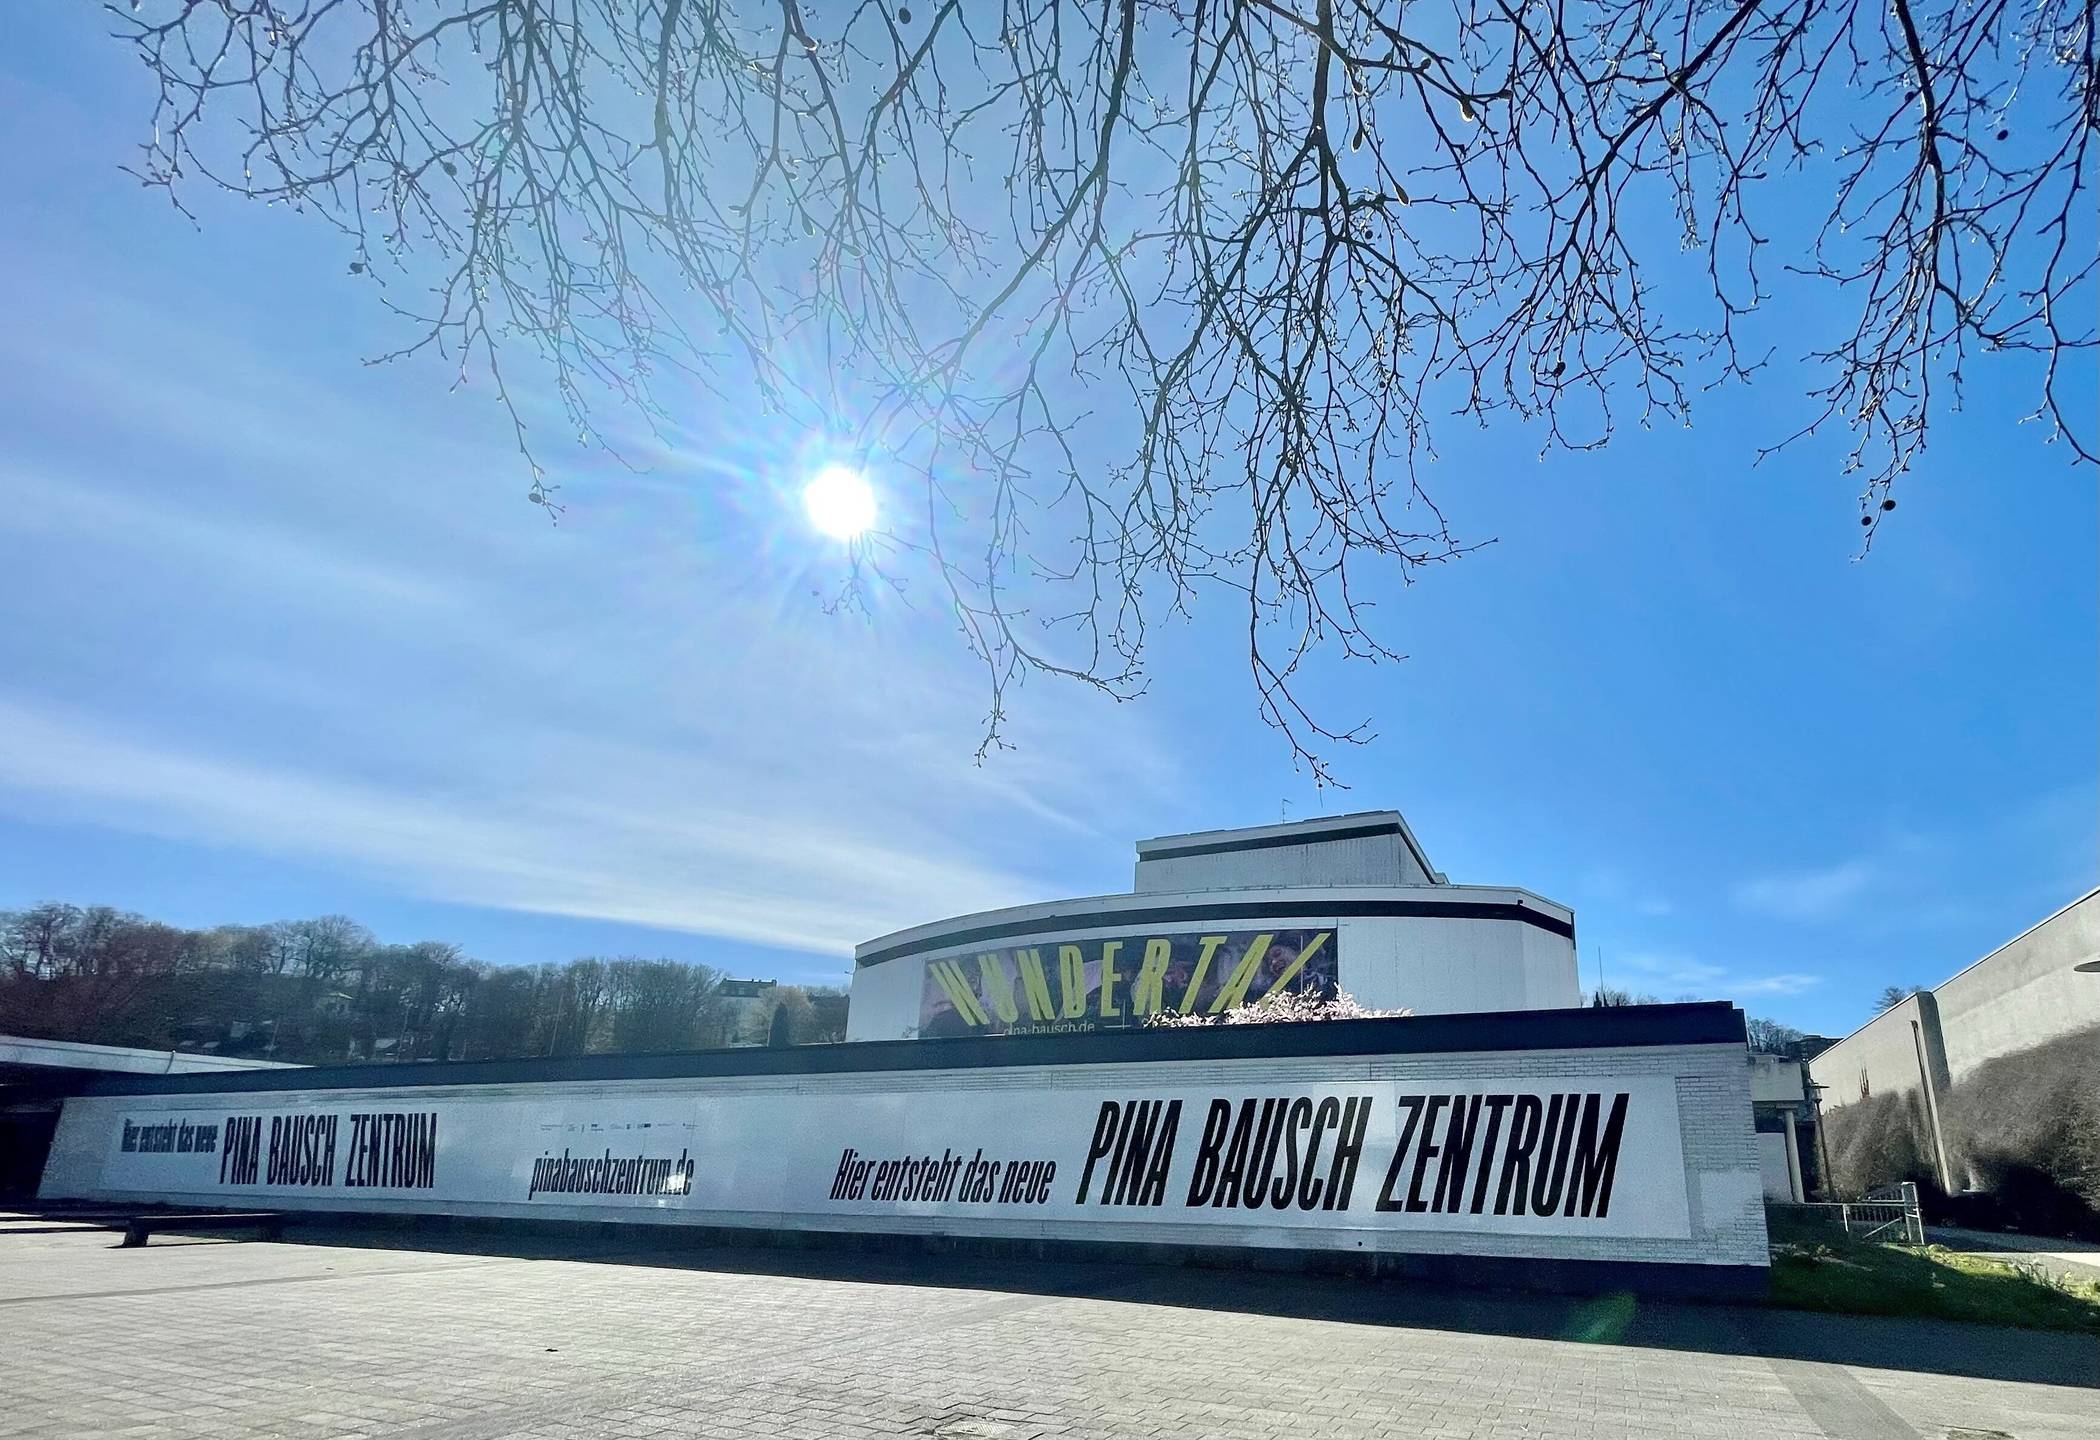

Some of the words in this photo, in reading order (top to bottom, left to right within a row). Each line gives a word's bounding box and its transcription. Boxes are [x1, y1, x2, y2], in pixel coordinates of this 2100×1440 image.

[219, 1116, 262, 1184] PINA
[267, 1114, 338, 1187] BAUSCH
[345, 1112, 437, 1188] ZENTRUM
[528, 1148, 695, 1201] pinabauschzentrum.de
[829, 1148, 877, 1201] Hier
[871, 1148, 963, 1202] entsteht
[958, 1148, 1001, 1203] das
[998, 1160, 1057, 1205] neue
[1075, 1099, 1184, 1207] PINA
[1185, 1096, 1374, 1212] BAUSCH
[1374, 1092, 1630, 1219] ZENTRUM
